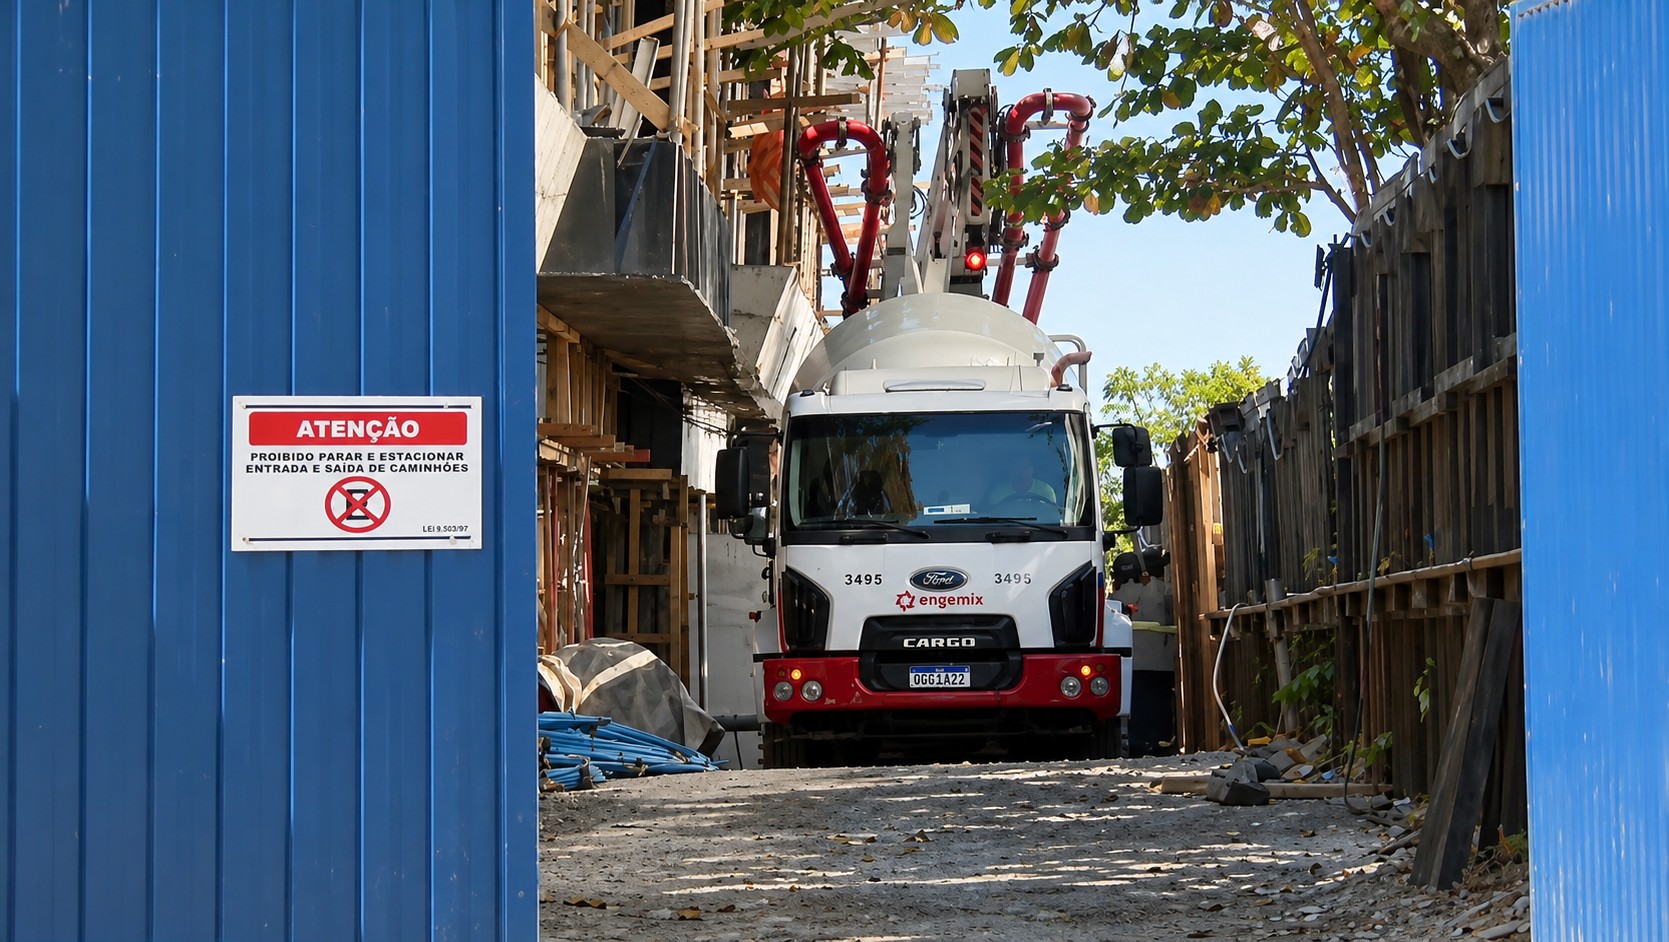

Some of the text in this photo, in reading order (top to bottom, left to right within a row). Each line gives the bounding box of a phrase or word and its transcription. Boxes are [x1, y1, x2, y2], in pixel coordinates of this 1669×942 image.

[296, 416, 420, 443] ATENÇÃO
[250, 452, 464, 462] PROIBIDO PARAR E ESTACIONAR
[246, 464, 308, 473] ENTRADA
[312, 464, 320, 473] E
[325, 462, 364, 473] SAÍDA
[369, 464, 386, 473] DE
[844, 574, 883, 586] 3495
[922, 571, 955, 585] Ford
[994, 573, 1032, 585] 3495
[919, 592, 984, 609] engemix
[903, 637, 976, 648] CARGO
